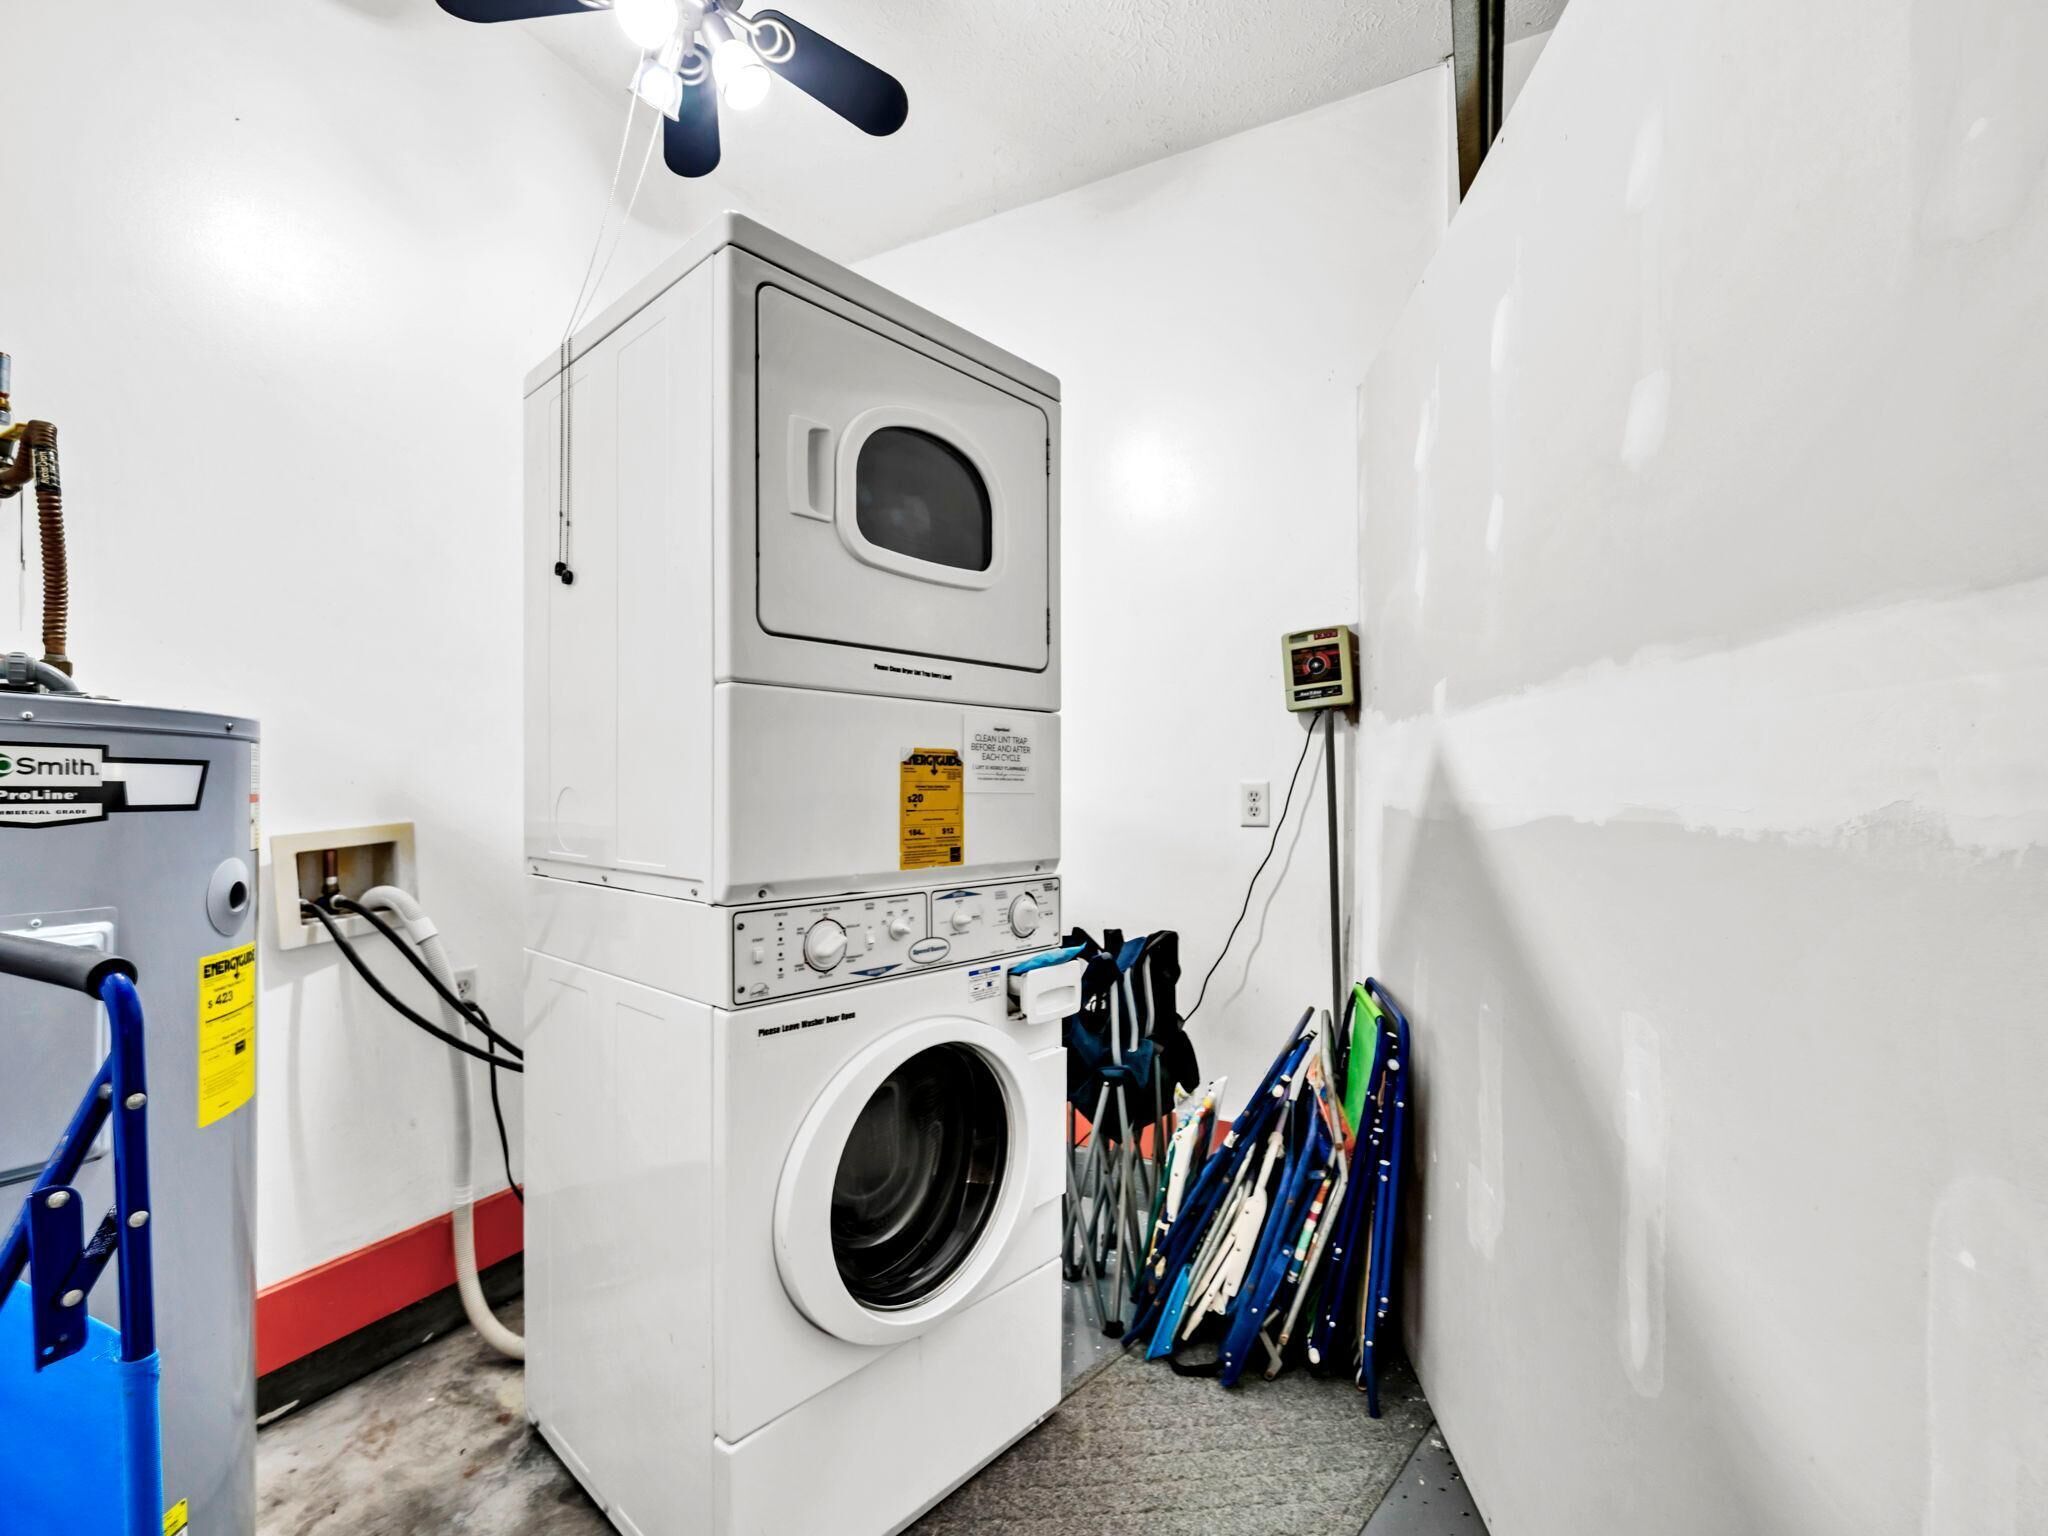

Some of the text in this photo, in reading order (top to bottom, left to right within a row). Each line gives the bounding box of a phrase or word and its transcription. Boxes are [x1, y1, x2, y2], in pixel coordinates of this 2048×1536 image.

[873, 663, 889, 672] Please
[975, 734, 1028, 746] CLEAN LINT TRAP
[971, 743, 1031, 754] BEFORE AND AFTER
[982, 753, 1021, 762] EACH CYCLE
[215, 990, 234, 1006] 423
[758, 1012, 856, 1038] Please Leave Washer Door Open
